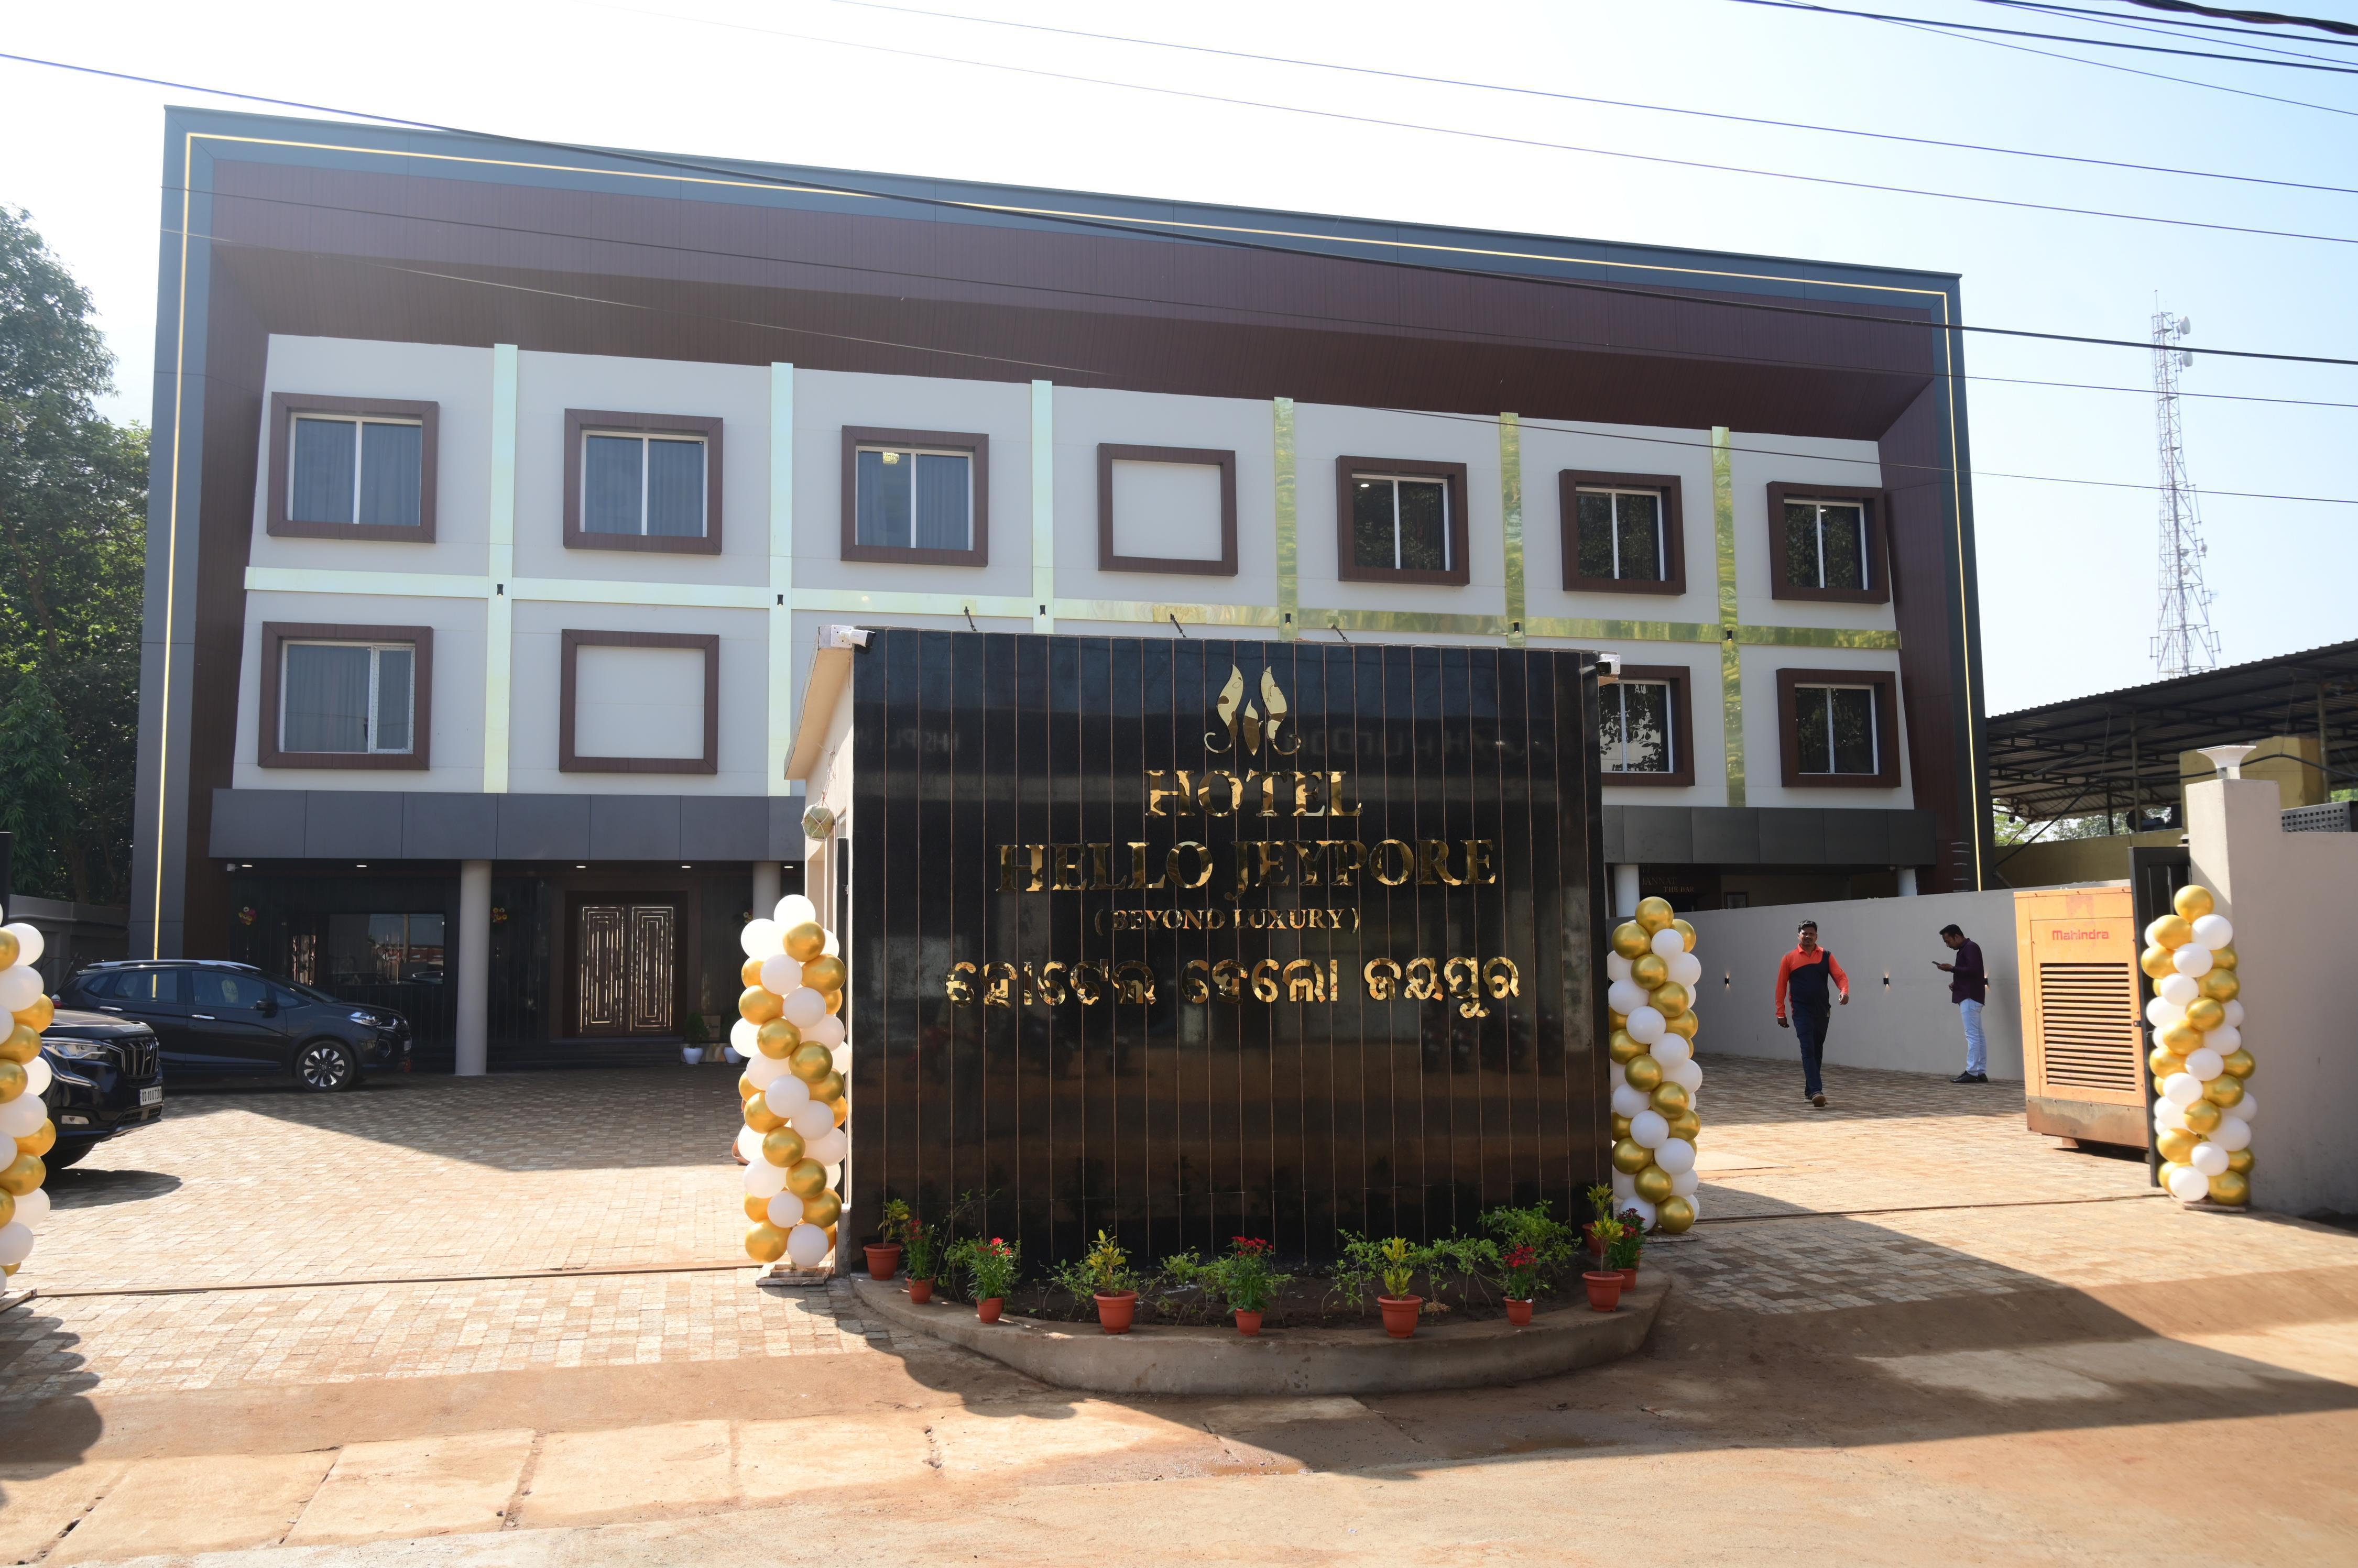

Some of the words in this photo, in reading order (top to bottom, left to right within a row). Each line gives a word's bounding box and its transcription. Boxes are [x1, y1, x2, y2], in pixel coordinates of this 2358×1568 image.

[1144, 769, 1362, 817] HOTEL
[996, 841, 1213, 891] HELLO
[1224, 839, 1496, 901] JEYPORE
[2052, 929, 2109, 940] Mahindra
[945, 959, 1157, 1008] ହୋଟେଲ
[1181, 959, 1338, 1004] ହେଲୋ
